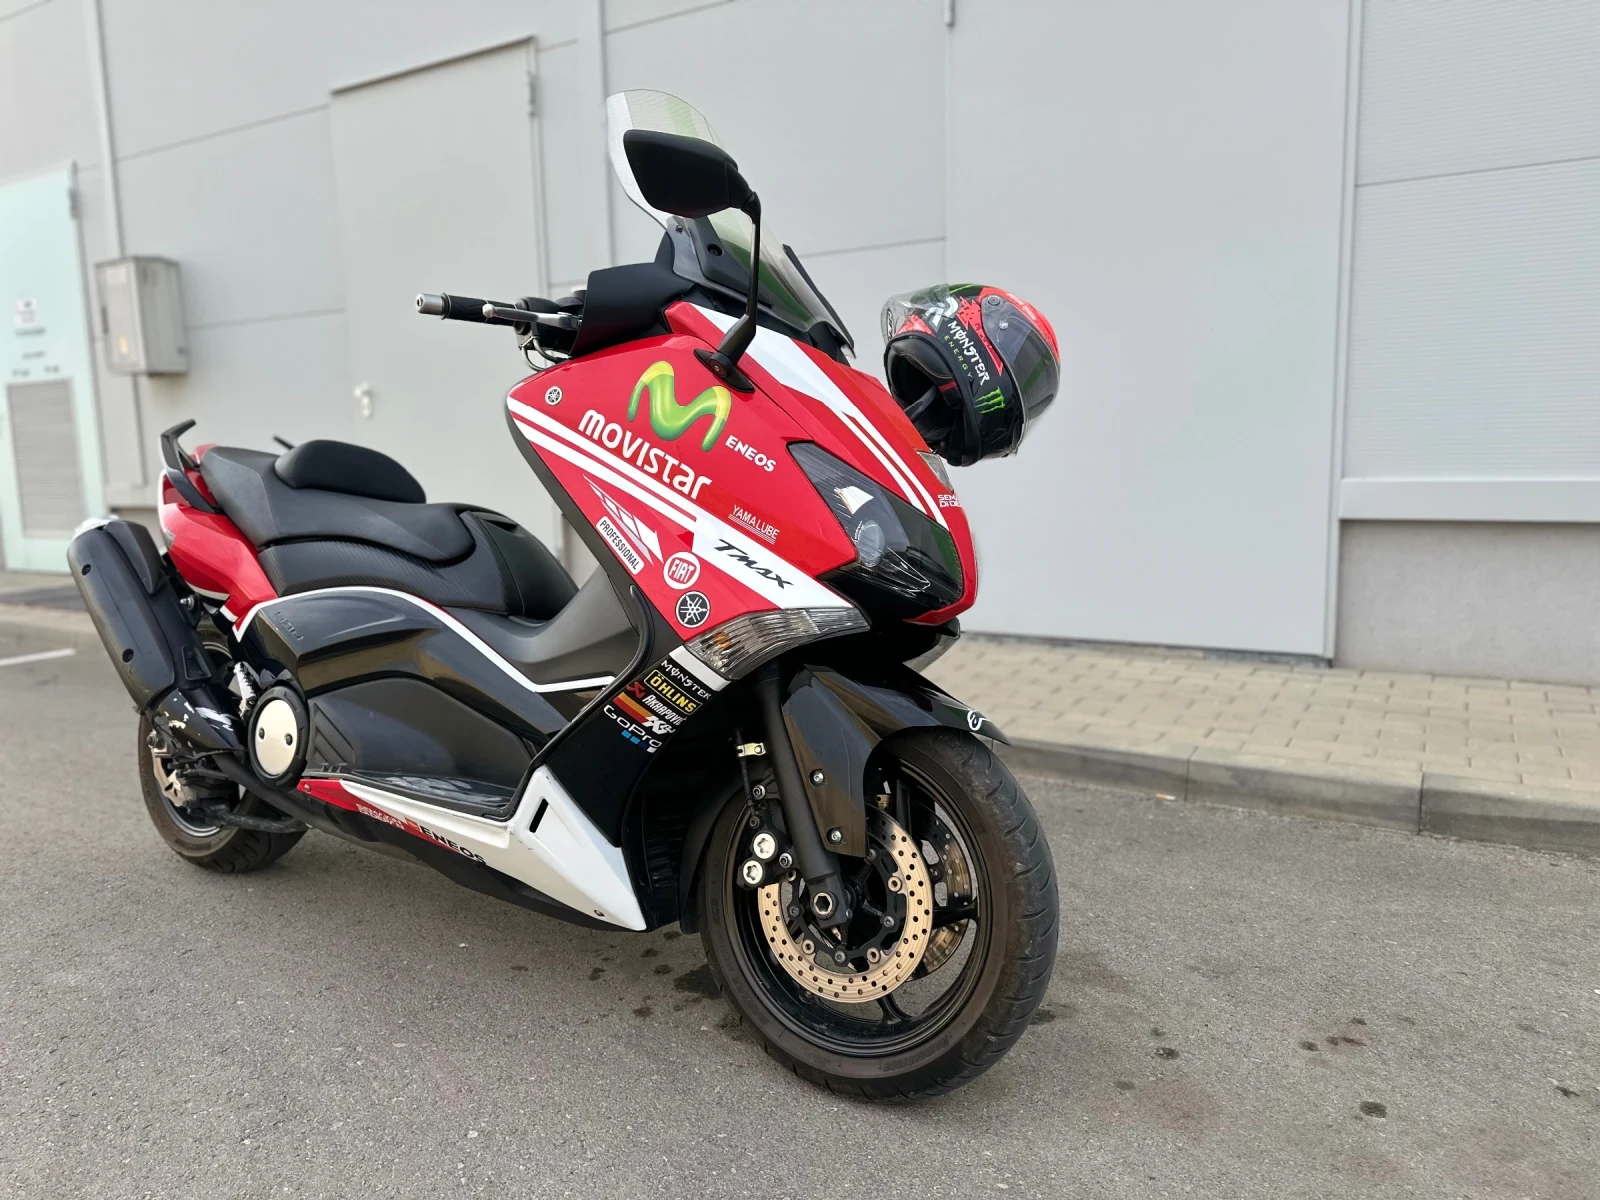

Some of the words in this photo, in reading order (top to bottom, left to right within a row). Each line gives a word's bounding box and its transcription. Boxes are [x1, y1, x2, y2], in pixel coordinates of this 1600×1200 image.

[944, 335, 973, 377] ENERGY
[948, 320, 990, 386] MONSTER
[724, 434, 777, 472] ENEOS
[731, 504, 781, 539] YAMALUBE
[599, 519, 640, 572] PROFESSIONAL
[667, 563, 696, 585] FIAT
[650, 673, 697, 713] ÖHLINS
[660, 660, 712, 701] MONSTER
[420, 825, 487, 866] ENEOS
